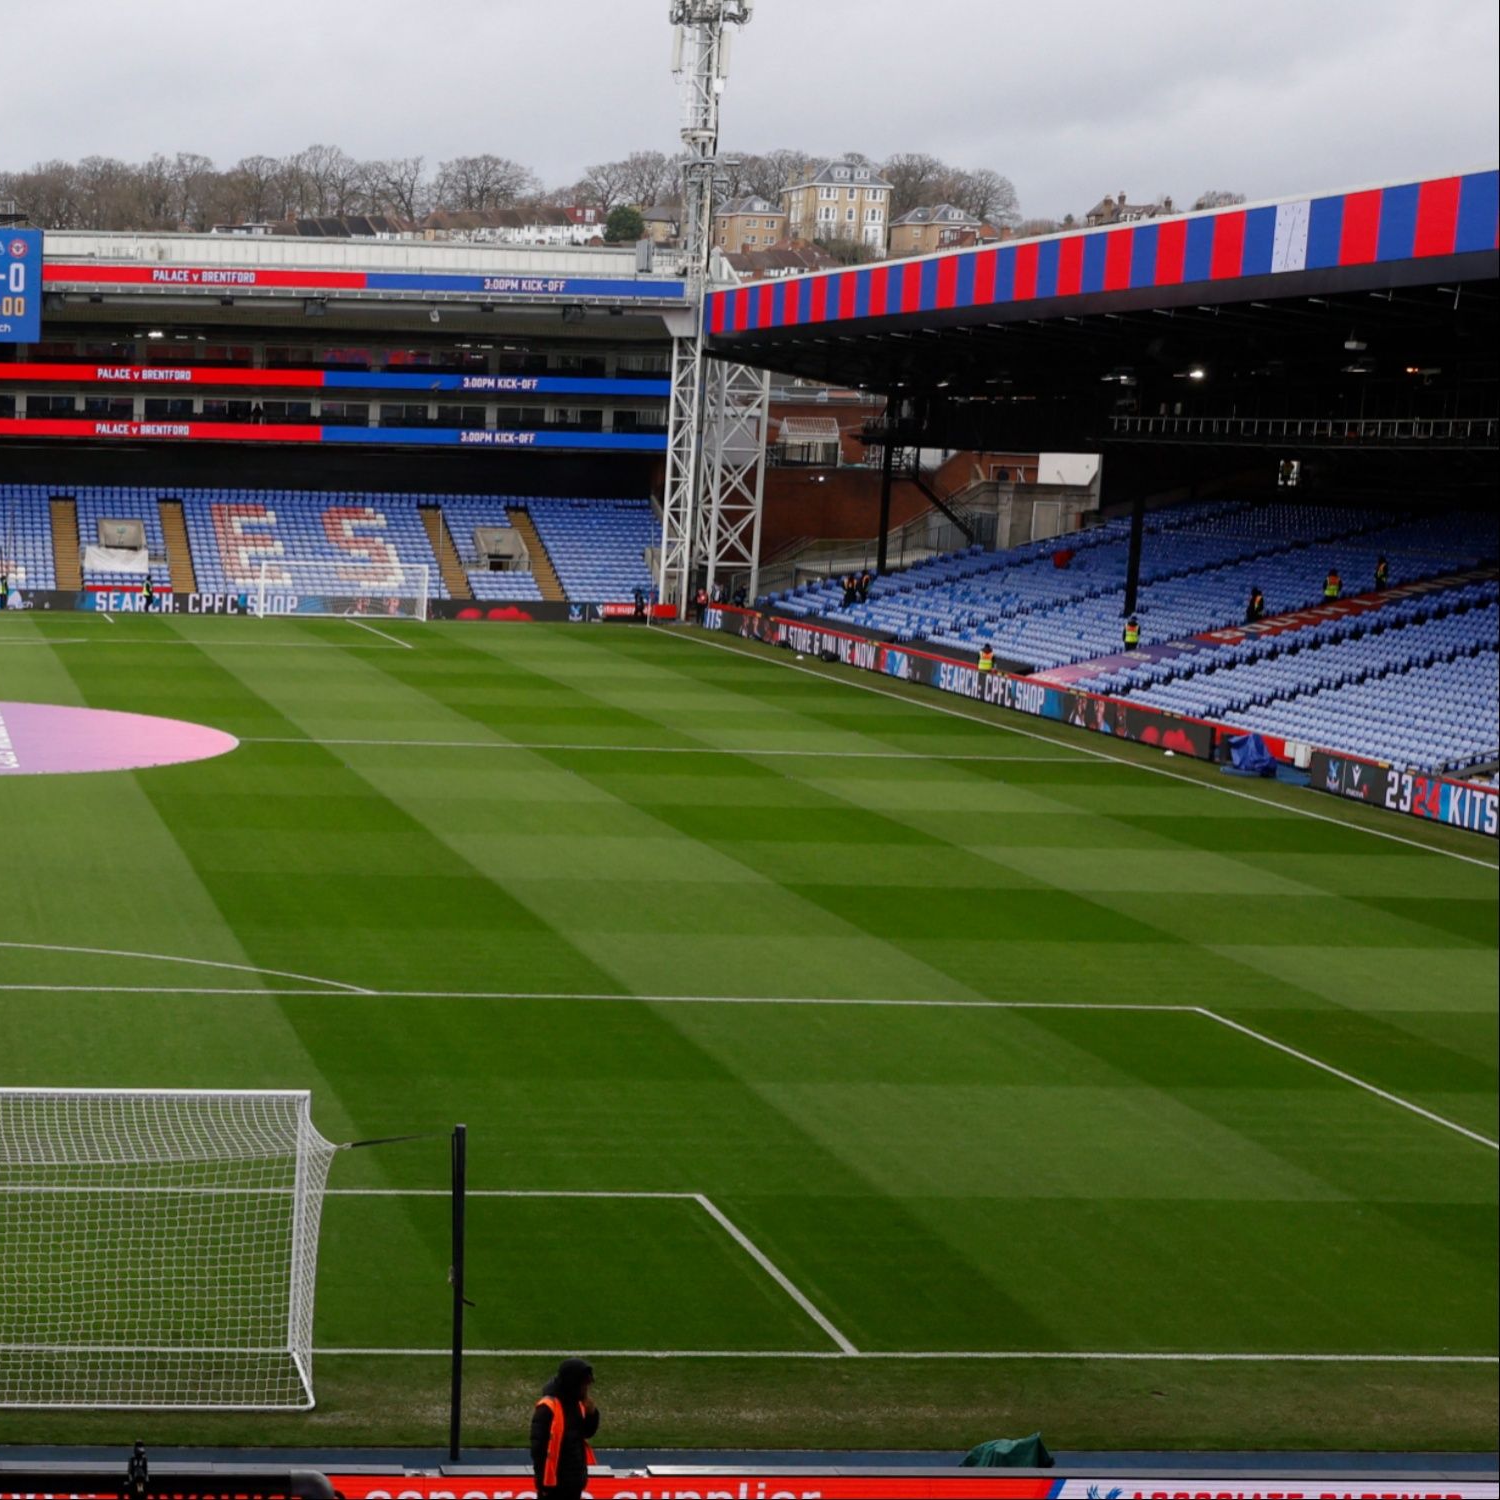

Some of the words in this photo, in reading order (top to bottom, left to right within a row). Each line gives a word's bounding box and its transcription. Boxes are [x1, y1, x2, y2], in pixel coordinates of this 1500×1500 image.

[152, 269, 190, 282] PALACE
[192, 272, 199, 282] v
[201, 271, 256, 284] BRENTFORD
[483, 278, 519, 291] 3:00PM
[521, 280, 566, 292] KICK-OFF
[97, 368, 131, 379] PALACE
[133, 371, 140, 379] v
[141, 369, 192, 381] BRENTFORD
[462, 377, 495, 388] 3:00PM
[497, 378, 539, 390] KICK-OFF
[95, 423, 129, 435] PALACE
[131, 426, 139, 435] v
[140, 425, 190, 436] BRENTFORD
[460, 431, 493, 443] 3:00PM
[494, 432, 536, 444] KICK-OFF
[187, 593, 238, 614] CPFC
[246, 594, 299, 616] SHOP
[778, 623, 787, 641] IN
[788, 626, 812, 653] STORE
[854, 641, 876, 670] NOW
[939, 662, 982, 699] SEARCH:
[984, 674, 1013, 707] CPFC
[1014, 682, 1046, 715] SHOP
[1446, 785, 1499, 835] KITS
